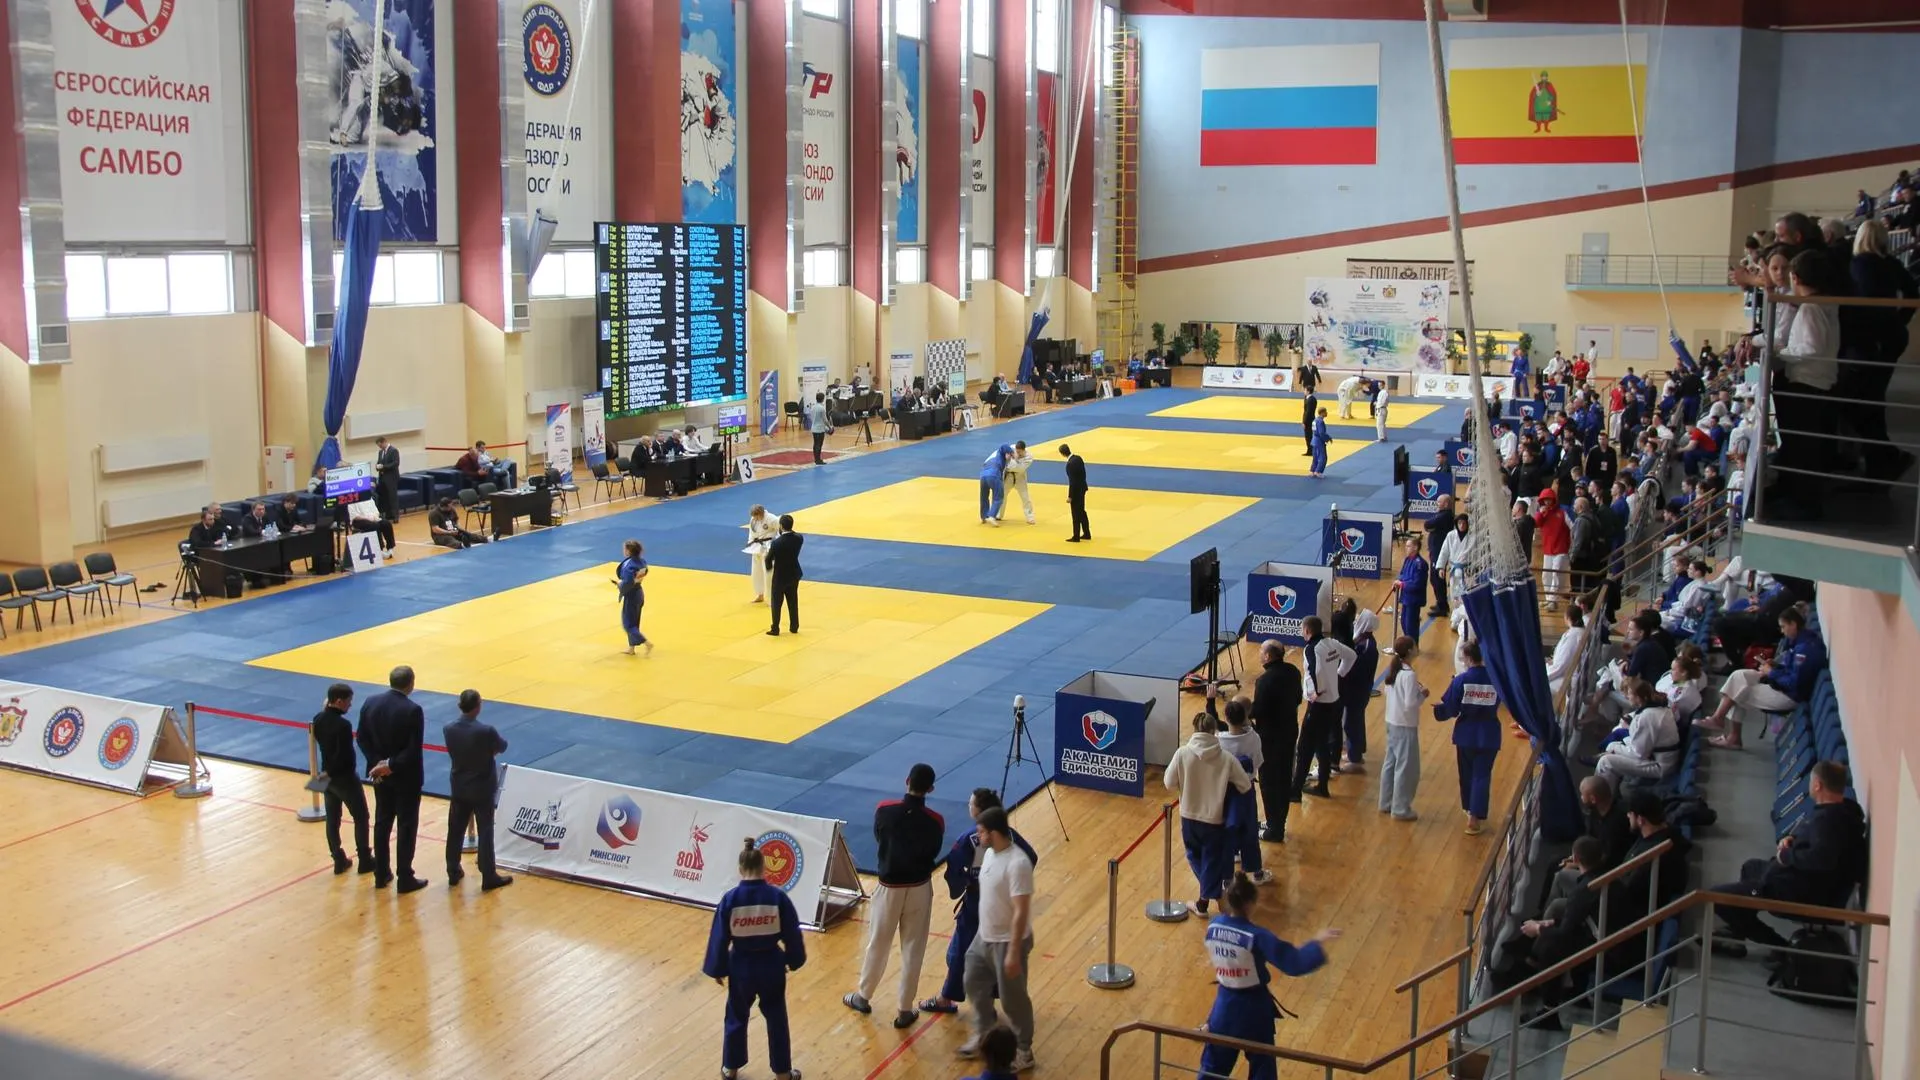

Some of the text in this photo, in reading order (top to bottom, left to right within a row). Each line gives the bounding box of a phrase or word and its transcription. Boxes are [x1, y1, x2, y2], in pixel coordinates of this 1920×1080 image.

[91, 17, 159, 46] САМБО
[538, 6, 564, 30] ДЗЮДО
[562, 32, 571, 78] РОССИИ
[54, 70, 210, 103] СЕРОССИЙСКАЯ
[537, 81, 554, 93] ФДР
[67, 107, 190, 136] ФЕДЕРАЦИЯ
[526, 122, 582, 141] ДЕРАЦИЯ
[804, 143, 819, 159] ЮЗ
[79, 146, 182, 176] САМБО
[803, 165, 834, 183] ОНДО
[803, 186, 824, 201] СИИ
[603, 276, 607, 287] 2
[604, 324, 608, 332] 3
[742, 458, 752, 479] 3
[358, 536, 376, 565] 4
[1252, 614, 1303, 627] АКАДЕМИ
[1251, 624, 1303, 636] ЕДИНОБОРС
[1465, 691, 1496, 699] FONBET
[1062, 748, 1138, 771] АКАДЕМИЯ
[1061, 761, 1138, 782] ЕДИНОБОРСТВ
[516, 806, 541, 821] ЛИГА
[513, 818, 567, 839] ПАТРИОТОВ
[760, 832, 797, 848] ОБЛАСТНАЯ
[589, 848, 632, 864] МИНСПОРТ
[676, 851, 693, 868] 80
[673, 868, 703, 882] ПОБЕДА!
[733, 915, 777, 928] FONBET
[1215, 946, 1237, 959] RUS
[1216, 966, 1251, 978] ONBET
